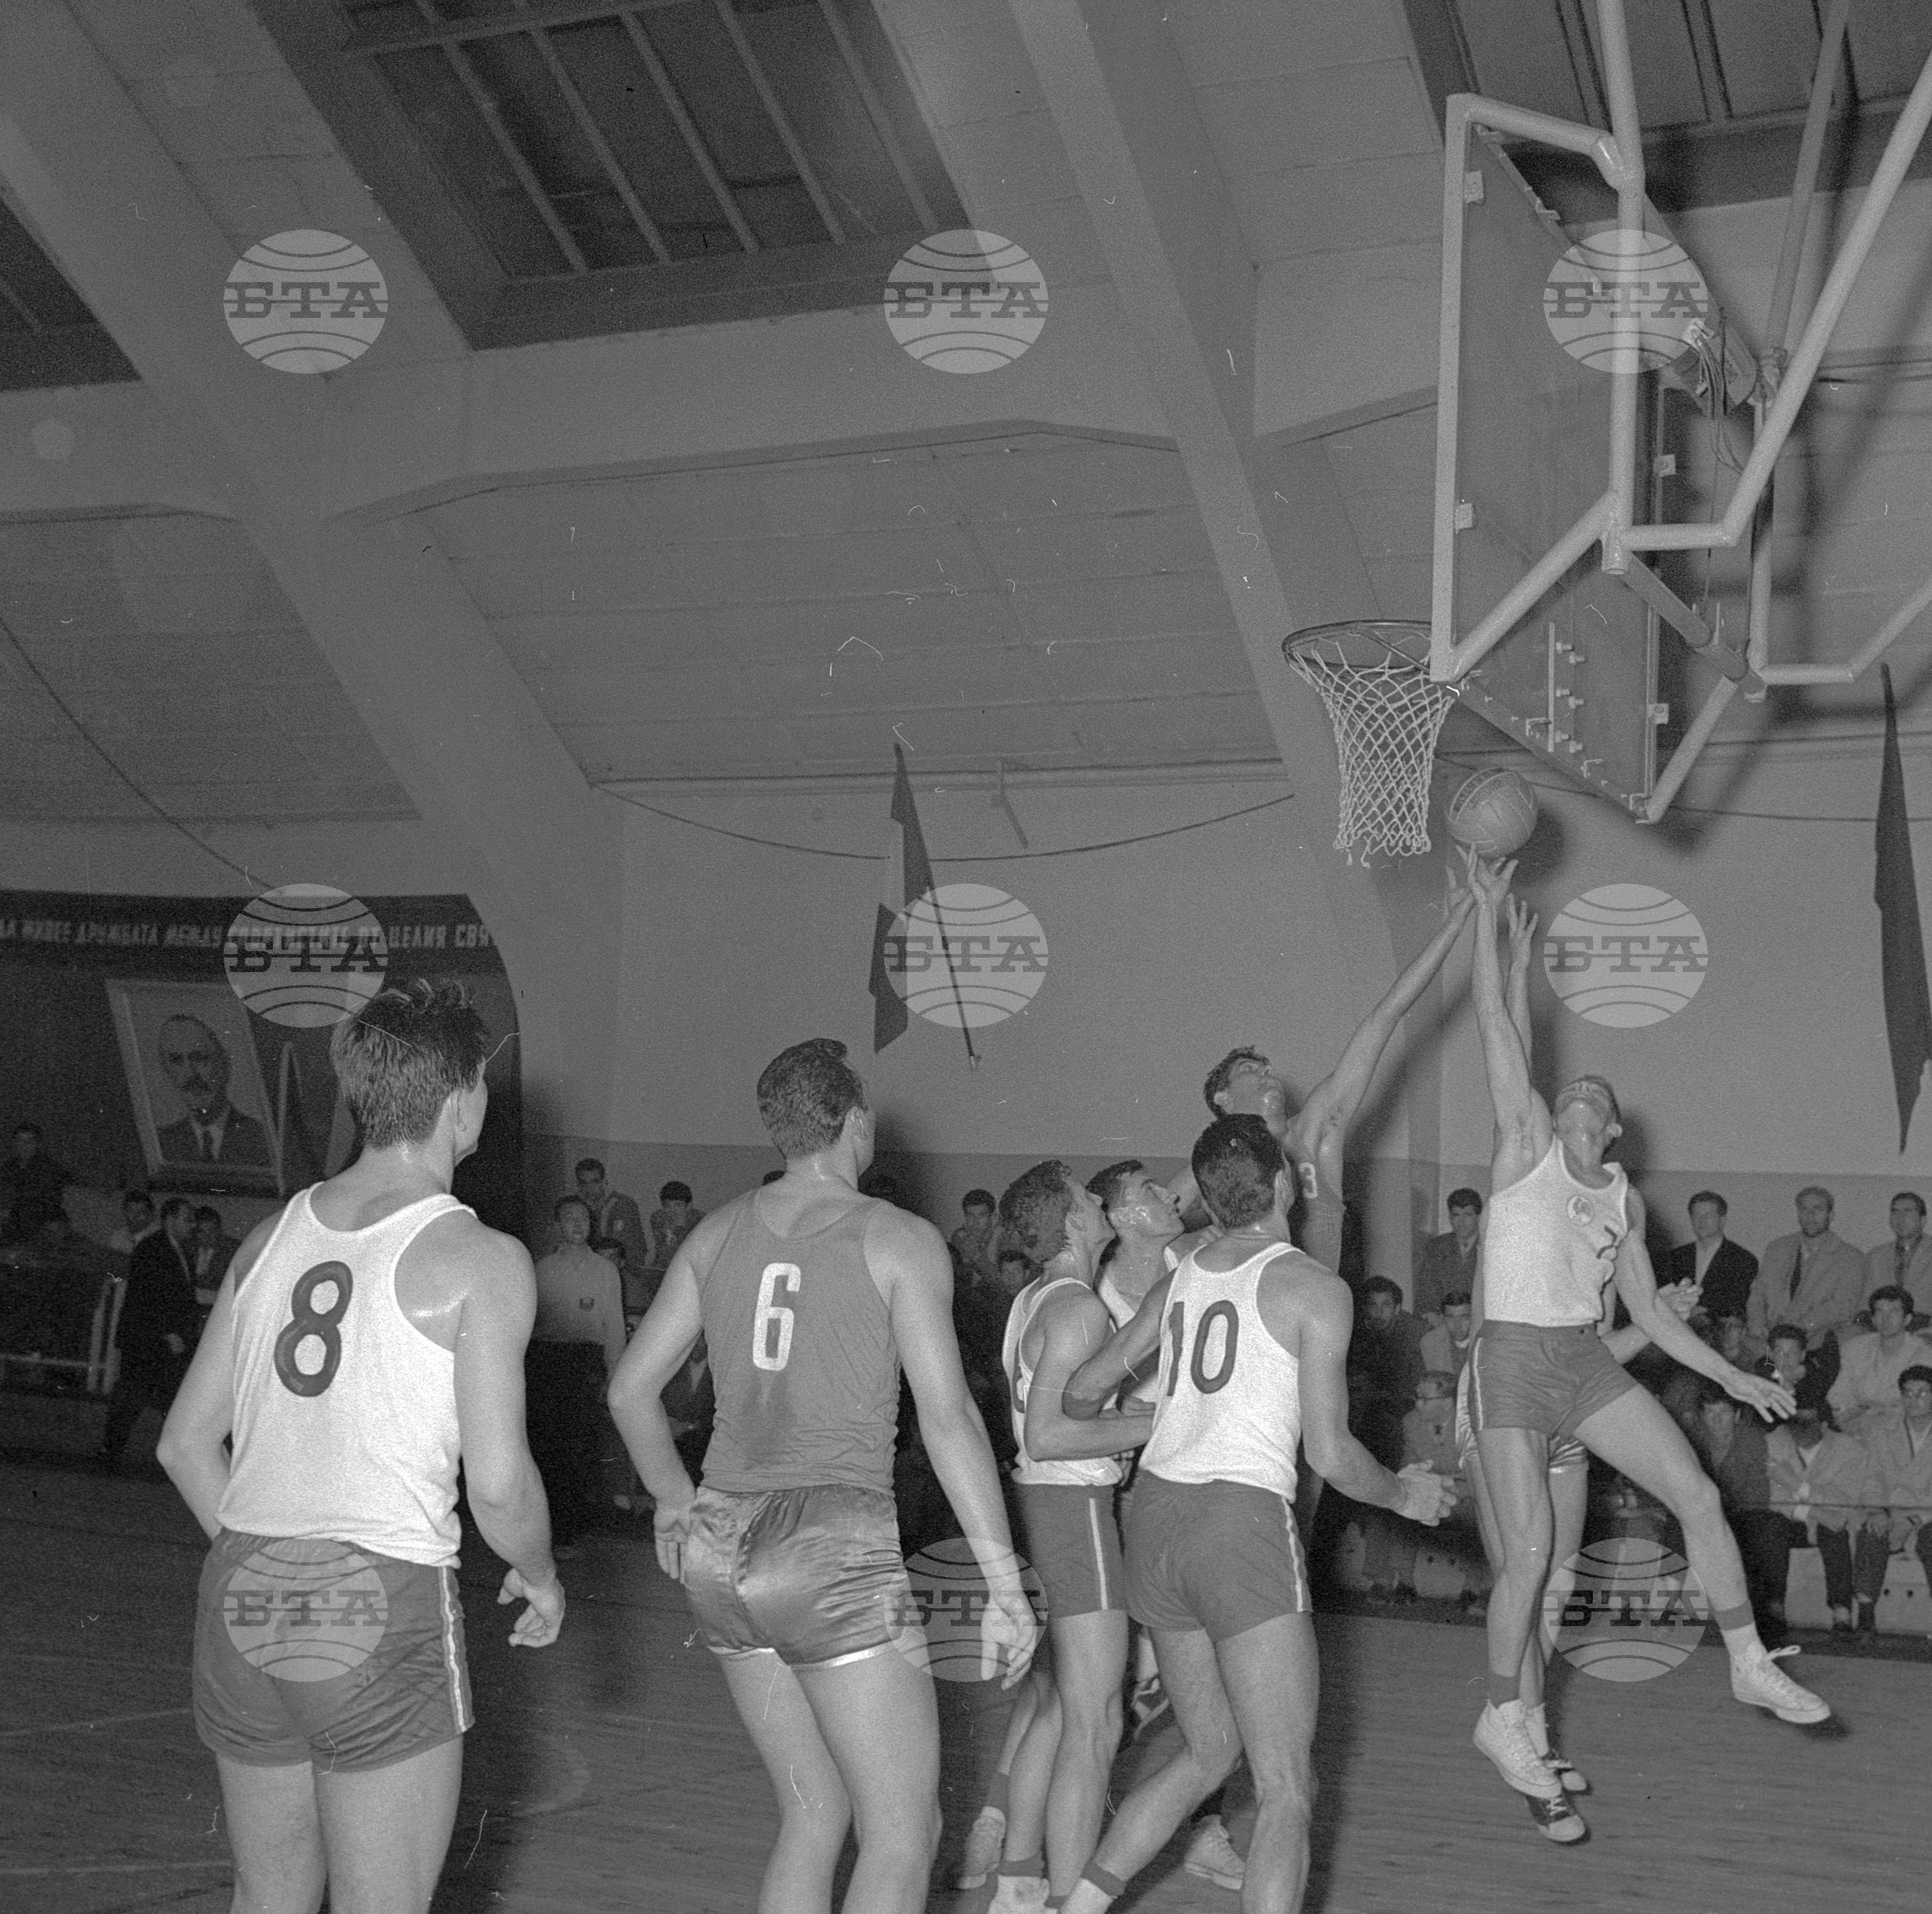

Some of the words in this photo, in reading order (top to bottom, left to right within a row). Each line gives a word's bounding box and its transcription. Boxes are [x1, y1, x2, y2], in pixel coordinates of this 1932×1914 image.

[163, 924, 223, 947] МЕЖДУ
[1298, 1162, 1318, 1199] 3
[274, 1260, 353, 1398] 8
[752, 1262, 801, 1371] 6
[1166, 1300, 1239, 1397] 10
